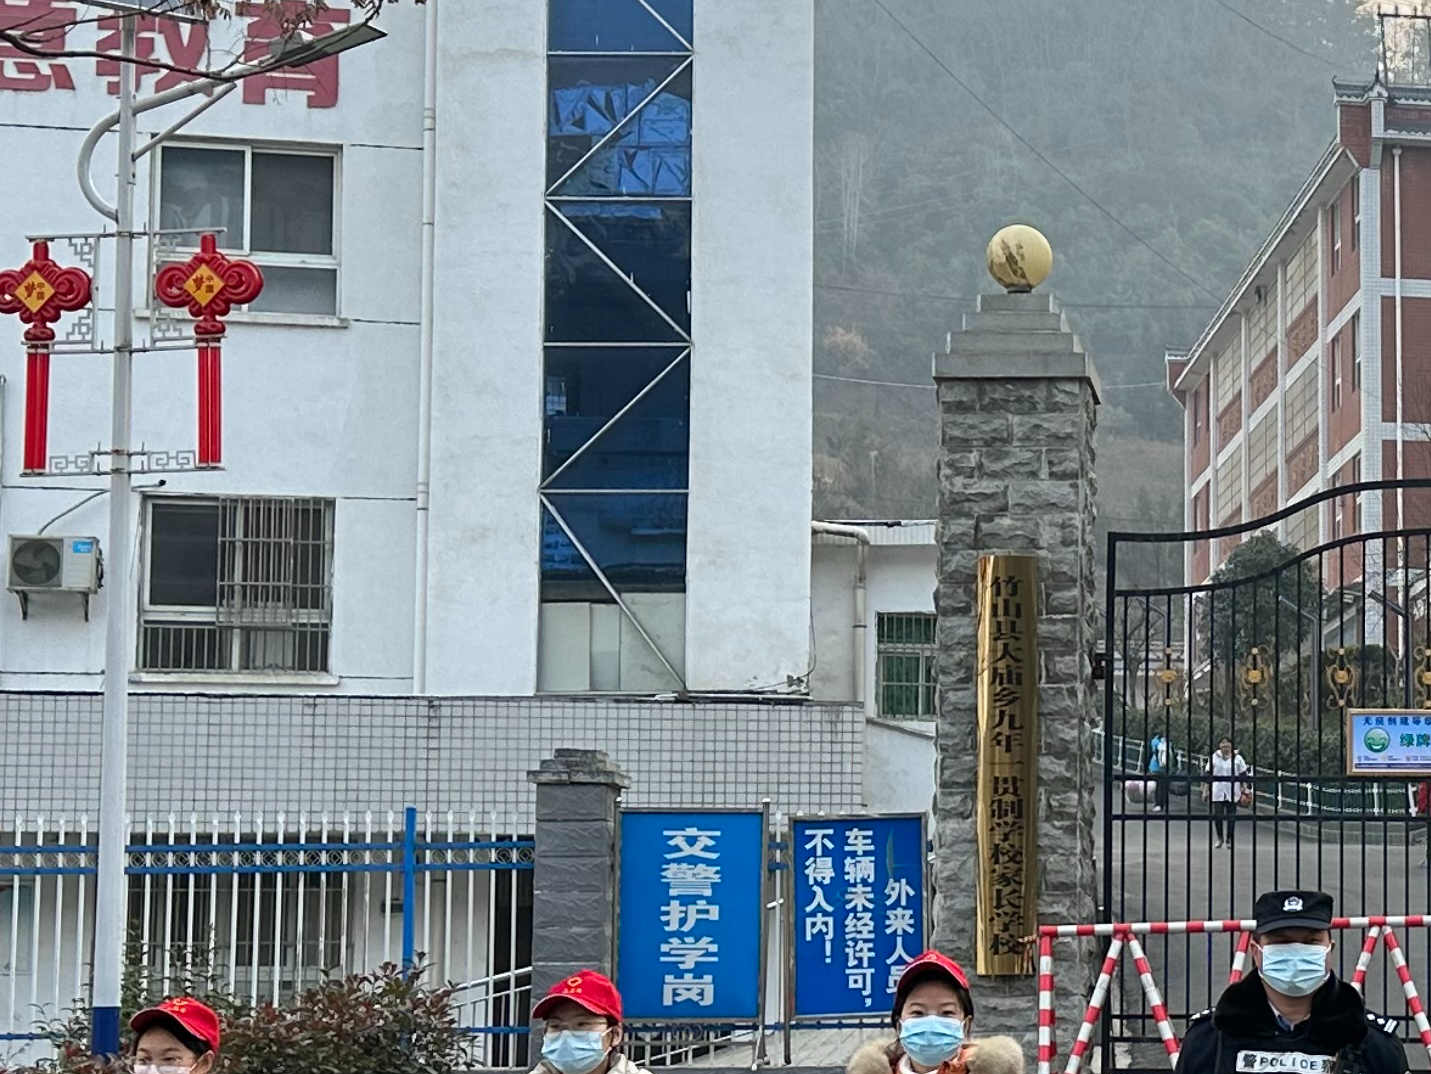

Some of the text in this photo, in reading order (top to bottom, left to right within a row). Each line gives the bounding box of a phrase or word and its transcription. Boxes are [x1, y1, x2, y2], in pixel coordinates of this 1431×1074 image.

[989, 575, 1024, 957] 竹山县大庙乡九年一贯制学校家长学校
[1399, 733, 1431, 748] 绿牌
[660, 827, 722, 1007] 交警护学岗
[804, 828, 835, 964] 不得入内！
